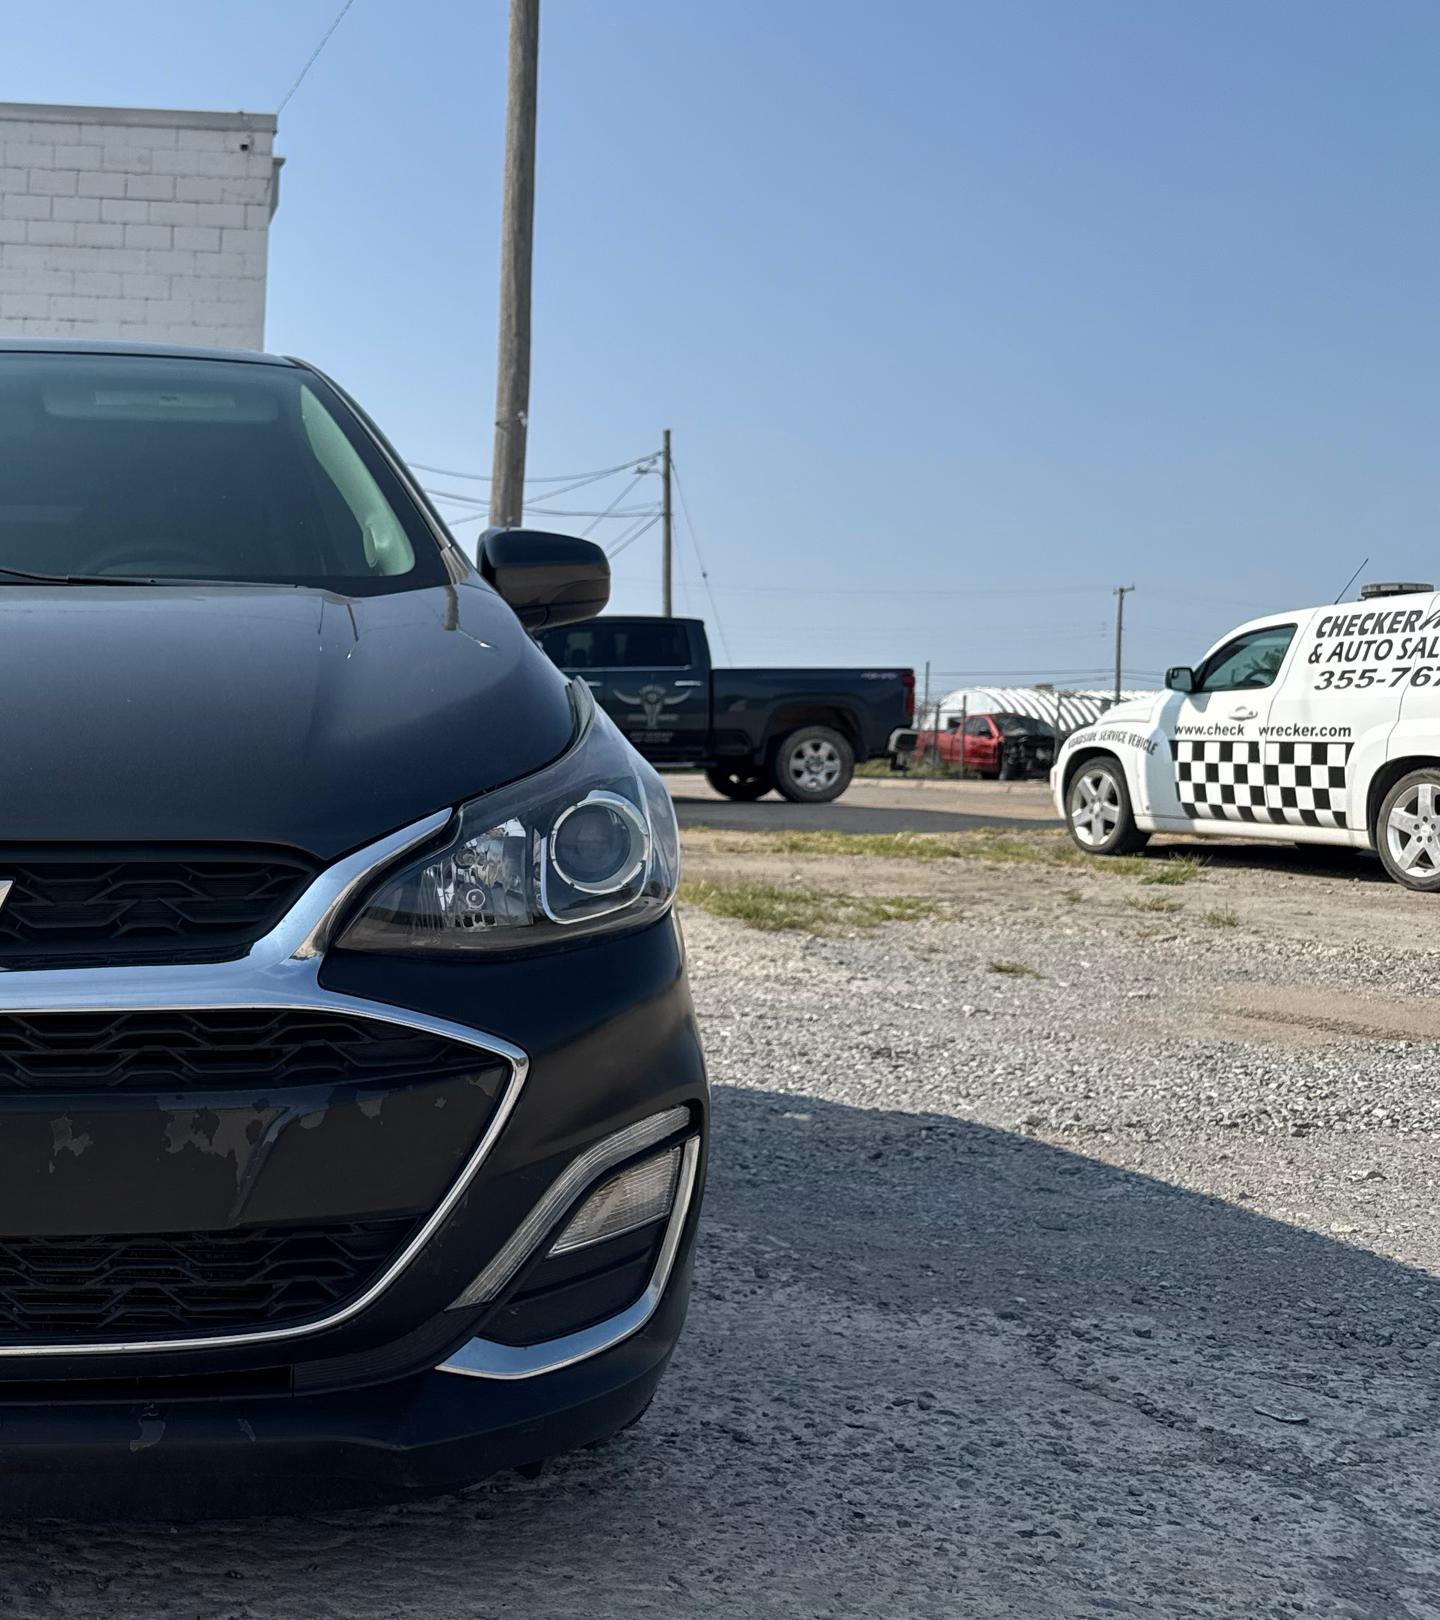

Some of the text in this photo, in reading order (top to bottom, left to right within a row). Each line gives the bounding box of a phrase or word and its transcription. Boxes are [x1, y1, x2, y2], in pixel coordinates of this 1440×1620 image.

[1316, 609, 1424, 639] CHECKER
[1308, 642, 1323, 664] &
[1325, 639, 1394, 663] AUTO
[1099, 729, 1128, 744] SERVICE
[1128, 733, 1158, 756] VEHICLE
